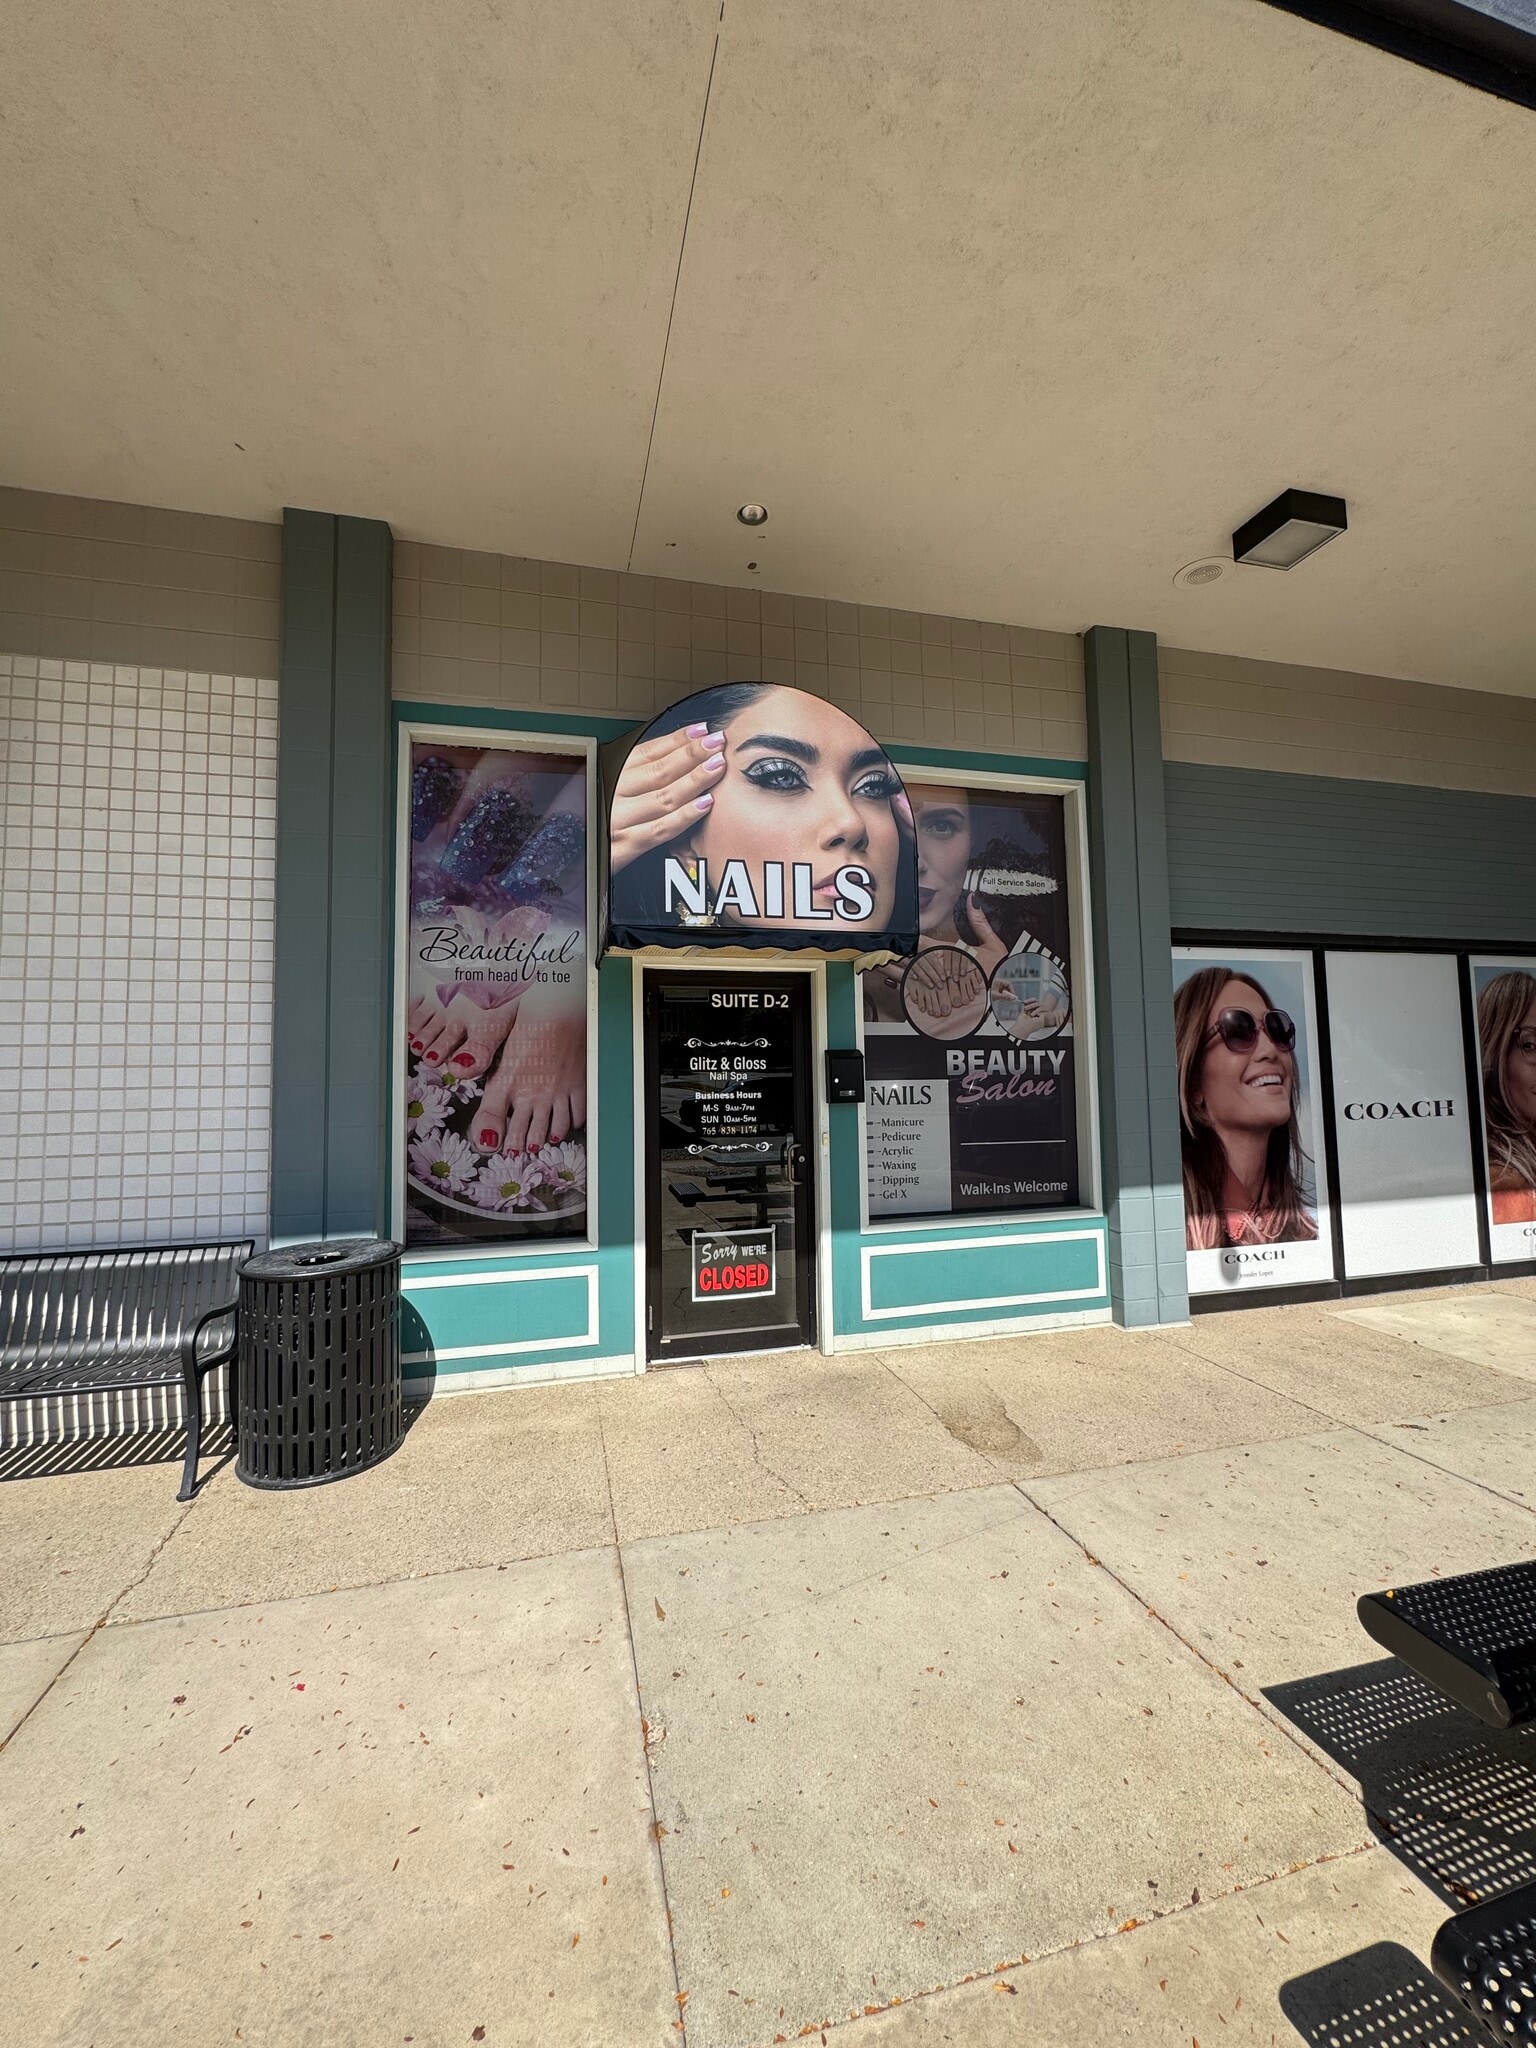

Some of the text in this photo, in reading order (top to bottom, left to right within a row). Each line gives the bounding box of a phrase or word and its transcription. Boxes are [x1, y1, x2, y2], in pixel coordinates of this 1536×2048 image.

[664, 857, 876, 922] NAILS
[982, 877, 1046, 888] Full Service Salon
[419, 926, 580, 981] Beautiful
[454, 967, 571, 983] from head to toe
[711, 993, 789, 1008] SUITE D-2
[689, 1056, 767, 1071] Glitz & Gloss
[946, 1049, 1067, 1076] BEAUTY
[709, 1071, 748, 1082] Nail Spa
[956, 1071, 1056, 1103] Salon
[695, 1091, 762, 1100] Business Hours
[870, 1085, 932, 1106] NAILS
[702, 1104, 755, 1112] M-S 9AM-7PM
[1344, 1099, 1455, 1121] COACH
[701, 1115, 757, 1124] SUN 10AM-5PM
[881, 1117, 925, 1127] Manicure
[702, 1127, 717, 1135] 765
[881, 1131, 922, 1141] Pedicure
[881, 1146, 914, 1157] Acrylic
[882, 1160, 917, 1171] Waxing
[882, 1174, 920, 1186] Dipping
[882, 1189, 908, 1199] Gel X
[960, 1180, 1068, 1196] Walk-Ins Welcome
[701, 1243, 767, 1264] Sorry WE'RE
[1224, 1250, 1285, 1265] COACH
[699, 1263, 769, 1291] CLOSED
